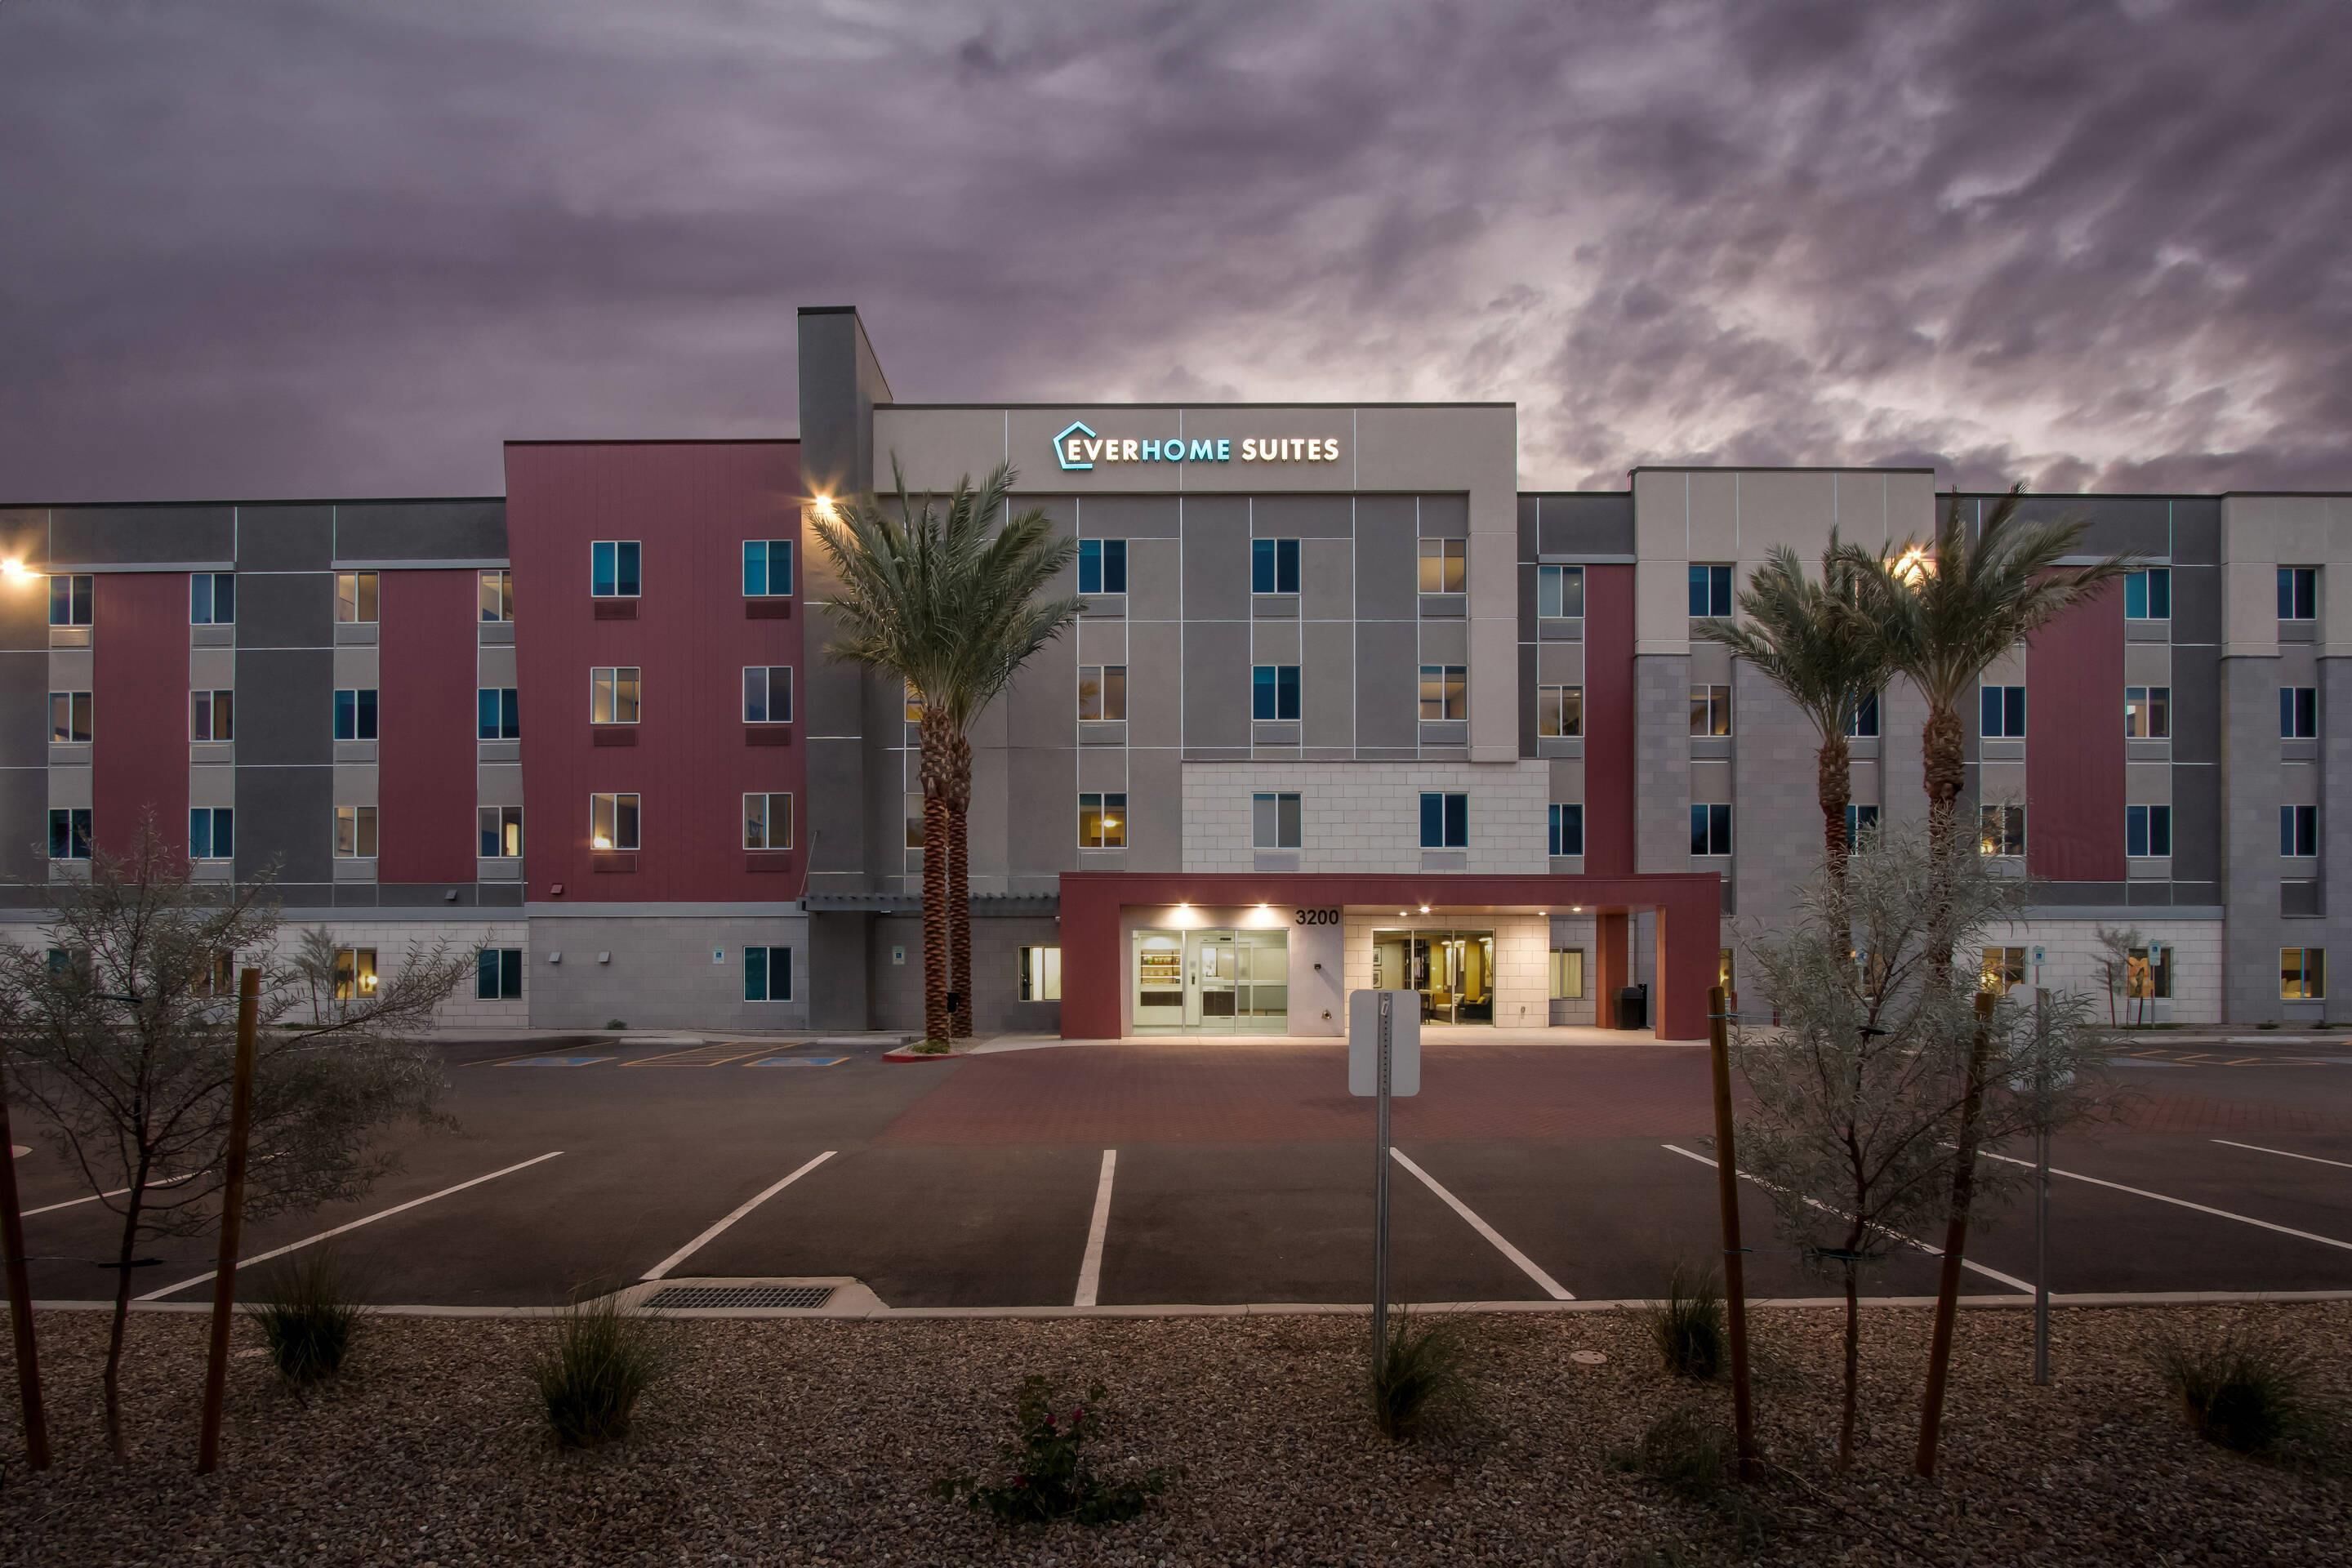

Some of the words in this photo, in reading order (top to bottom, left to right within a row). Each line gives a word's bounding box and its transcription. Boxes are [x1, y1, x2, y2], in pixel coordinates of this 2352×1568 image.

[1067, 439, 1230, 462] EVERHOME
[1241, 438, 1339, 462] SUITES
[1295, 909, 1339, 925] 3200
